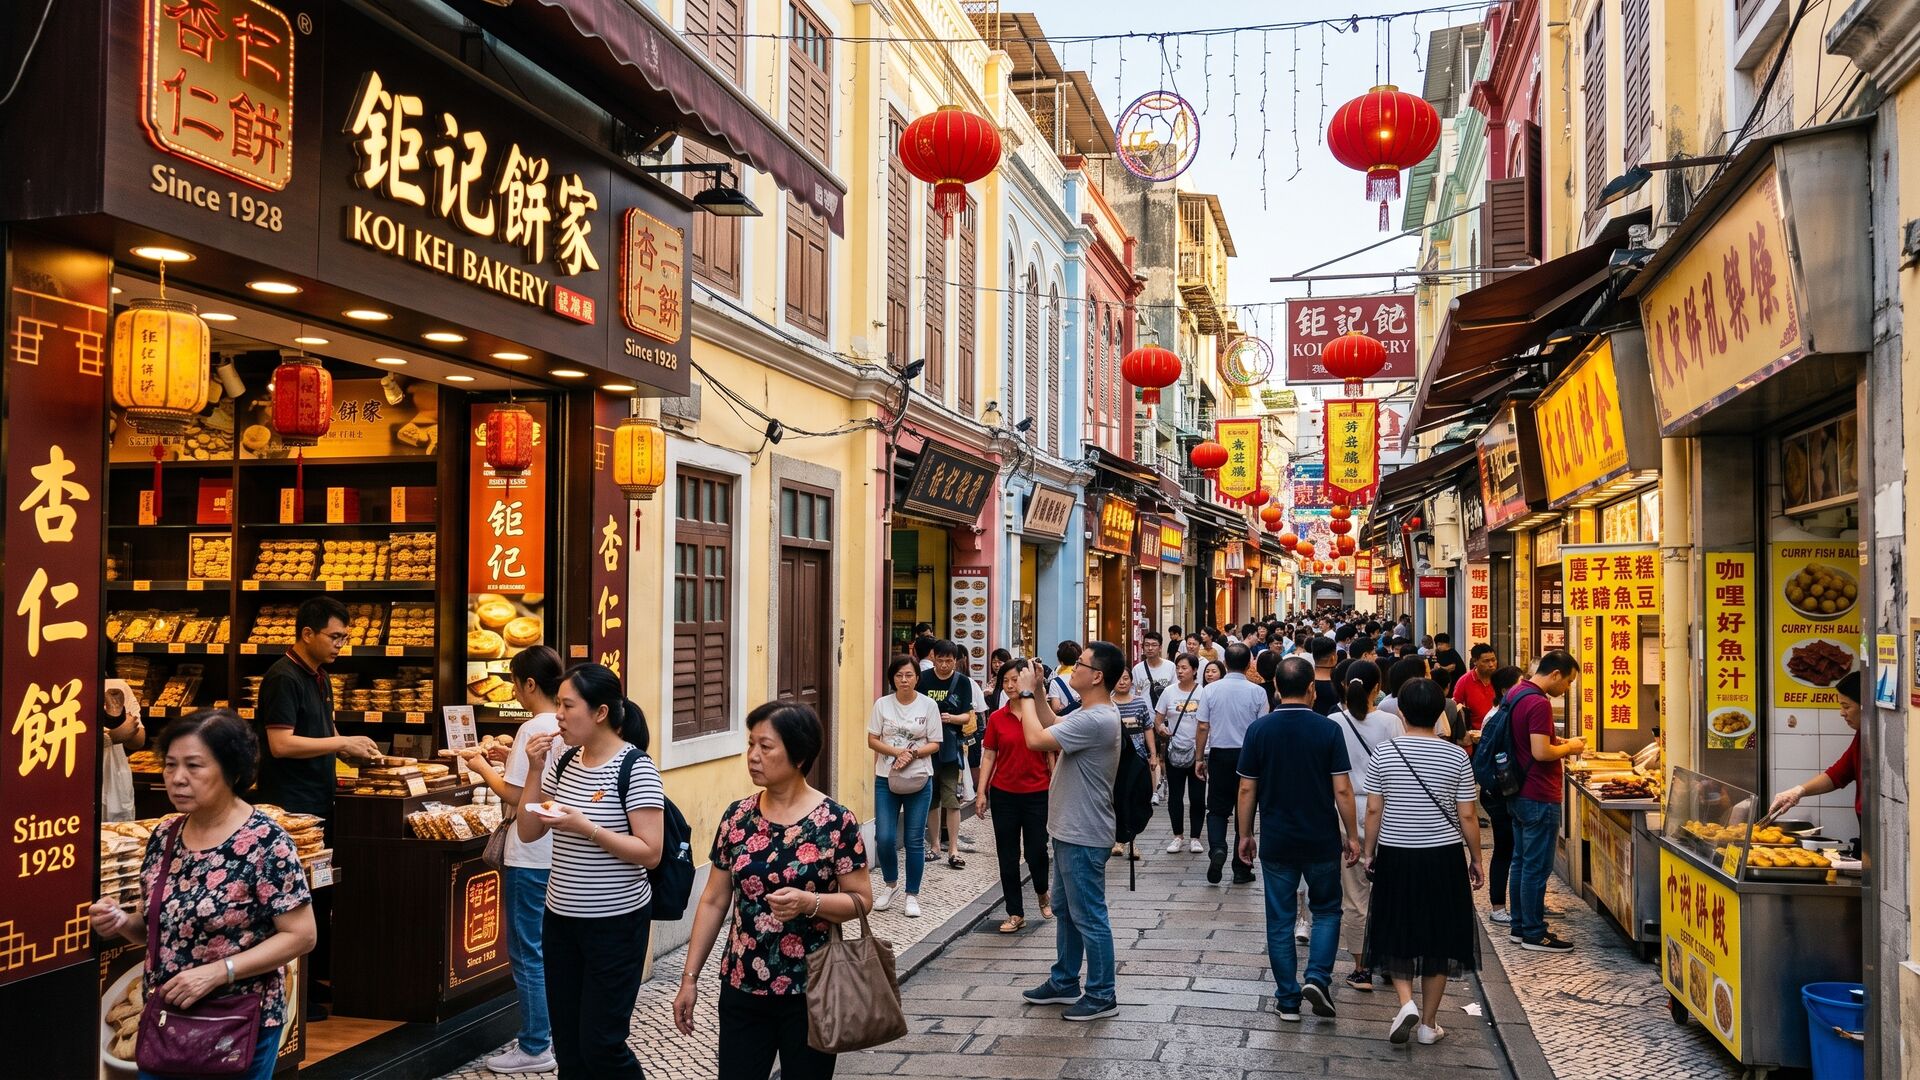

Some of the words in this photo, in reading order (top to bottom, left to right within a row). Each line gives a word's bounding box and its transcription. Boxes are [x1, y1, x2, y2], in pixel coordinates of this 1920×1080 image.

[150, 164, 220, 212] Since
[228, 191, 283, 232] 1928
[353, 206, 405, 256] KOI
[415, 230, 454, 274] KEI
[464, 257, 549, 307] BAKERY
[625, 338, 652, 362] Since
[655, 348, 677, 371] 1928
[1781, 548, 1813, 558] CURRY
[1815, 548, 1836, 558] FISH
[12, 445, 90, 778] 杏仁餅
[1715, 558, 1746, 689] 咖哩好魚汁
[1781, 624, 1812, 634] CURRY
[1814, 624, 1835, 634] FISH
[1837, 624, 1860, 634] BALL
[1783, 692, 1808, 703] BEEF
[14, 814, 80, 844] Since
[18, 843, 76, 879] 1928
